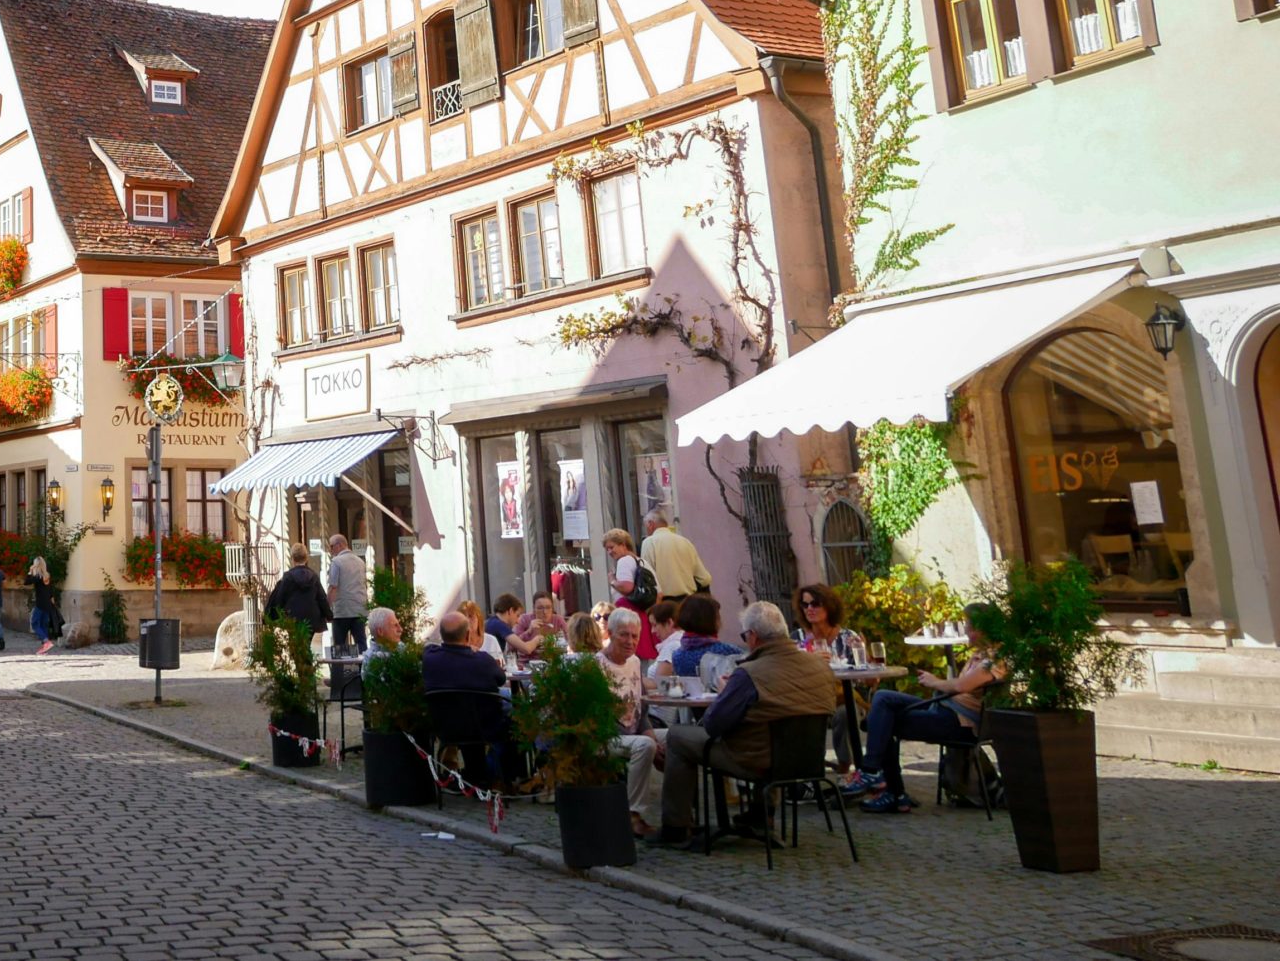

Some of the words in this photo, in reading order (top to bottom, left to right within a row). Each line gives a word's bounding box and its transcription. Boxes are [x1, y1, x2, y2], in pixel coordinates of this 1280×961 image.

[112, 405, 246, 428] Mausturm
[137, 433, 227, 446] RSTAURANT
[1029, 452, 1084, 493] EIS
